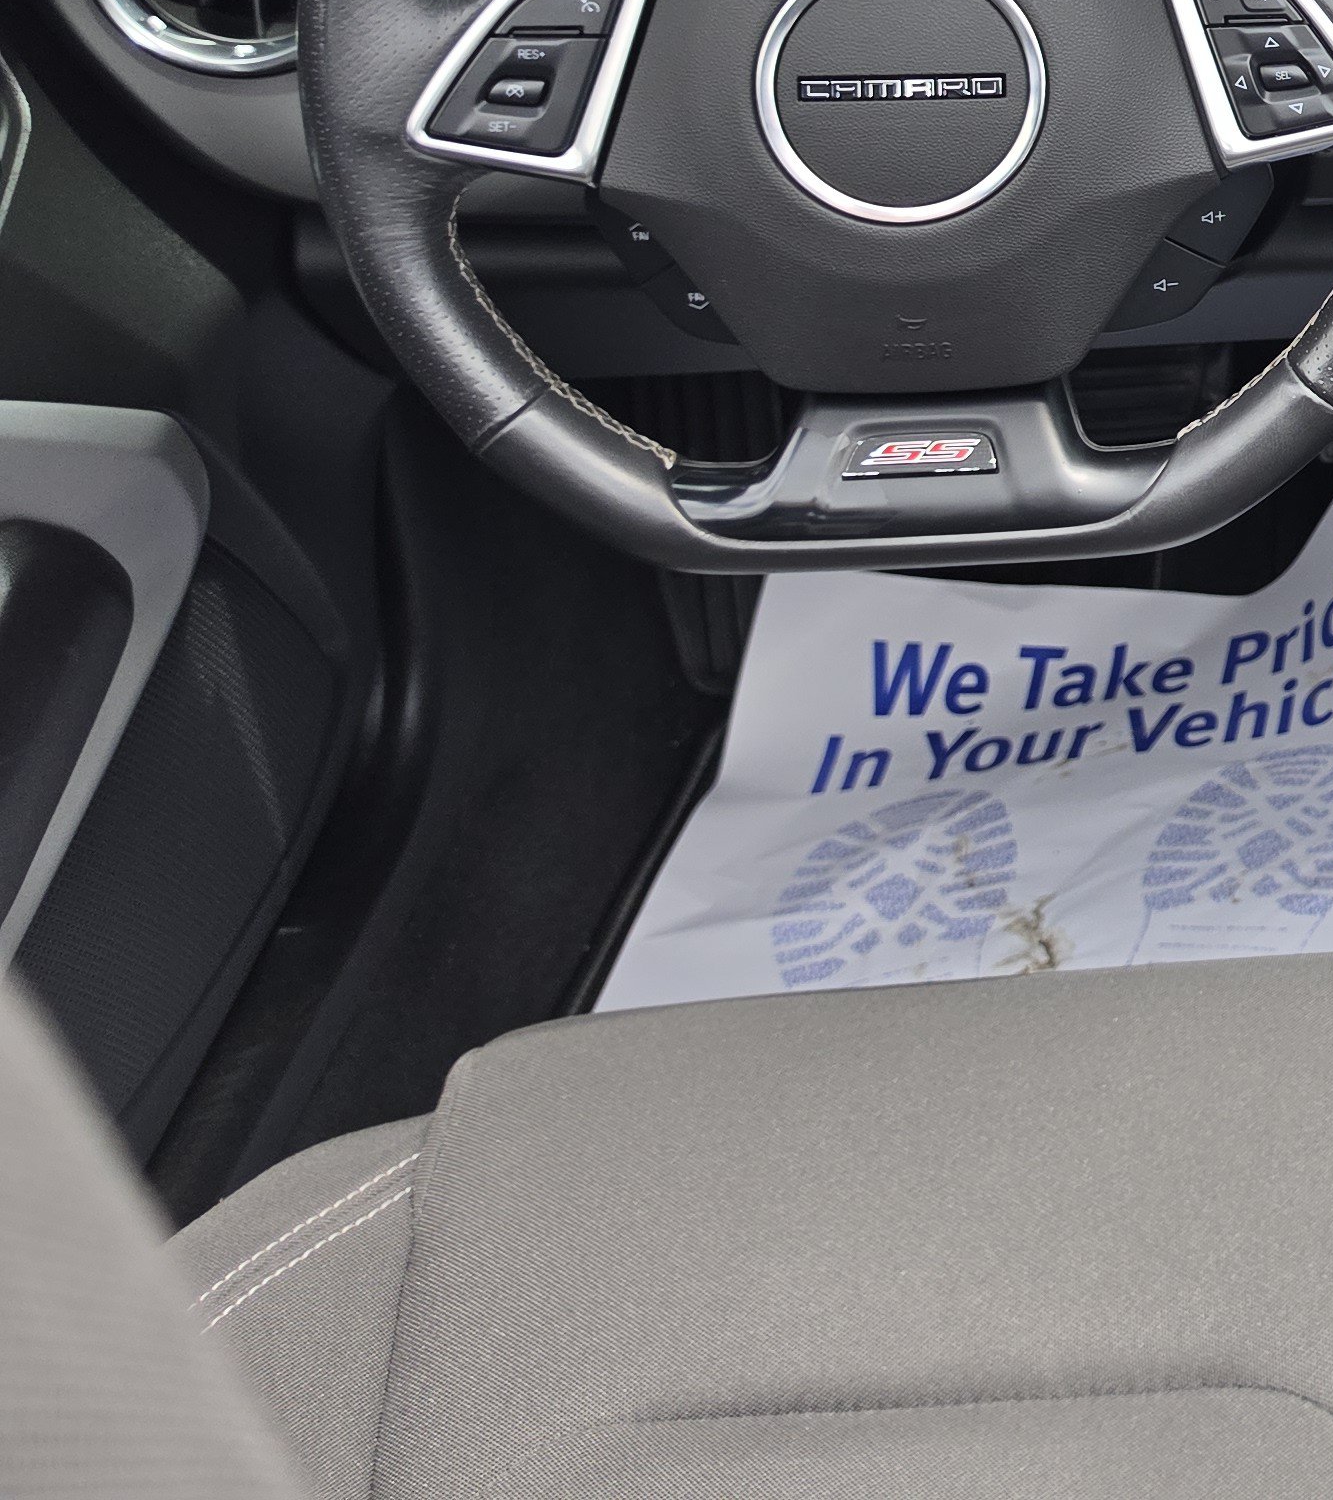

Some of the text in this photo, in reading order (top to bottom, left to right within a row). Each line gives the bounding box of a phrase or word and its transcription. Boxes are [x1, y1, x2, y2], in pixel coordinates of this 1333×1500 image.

[517, 48, 546, 61] RES+
[800, 76, 1003, 99] CAMARO
[1275, 70, 1292, 82] SEL
[861, 438, 982, 466] SS
[871, 639, 990, 718] We
[1018, 642, 1195, 712] Take
[810, 734, 894, 795] In
[923, 719, 1105, 780] Your
